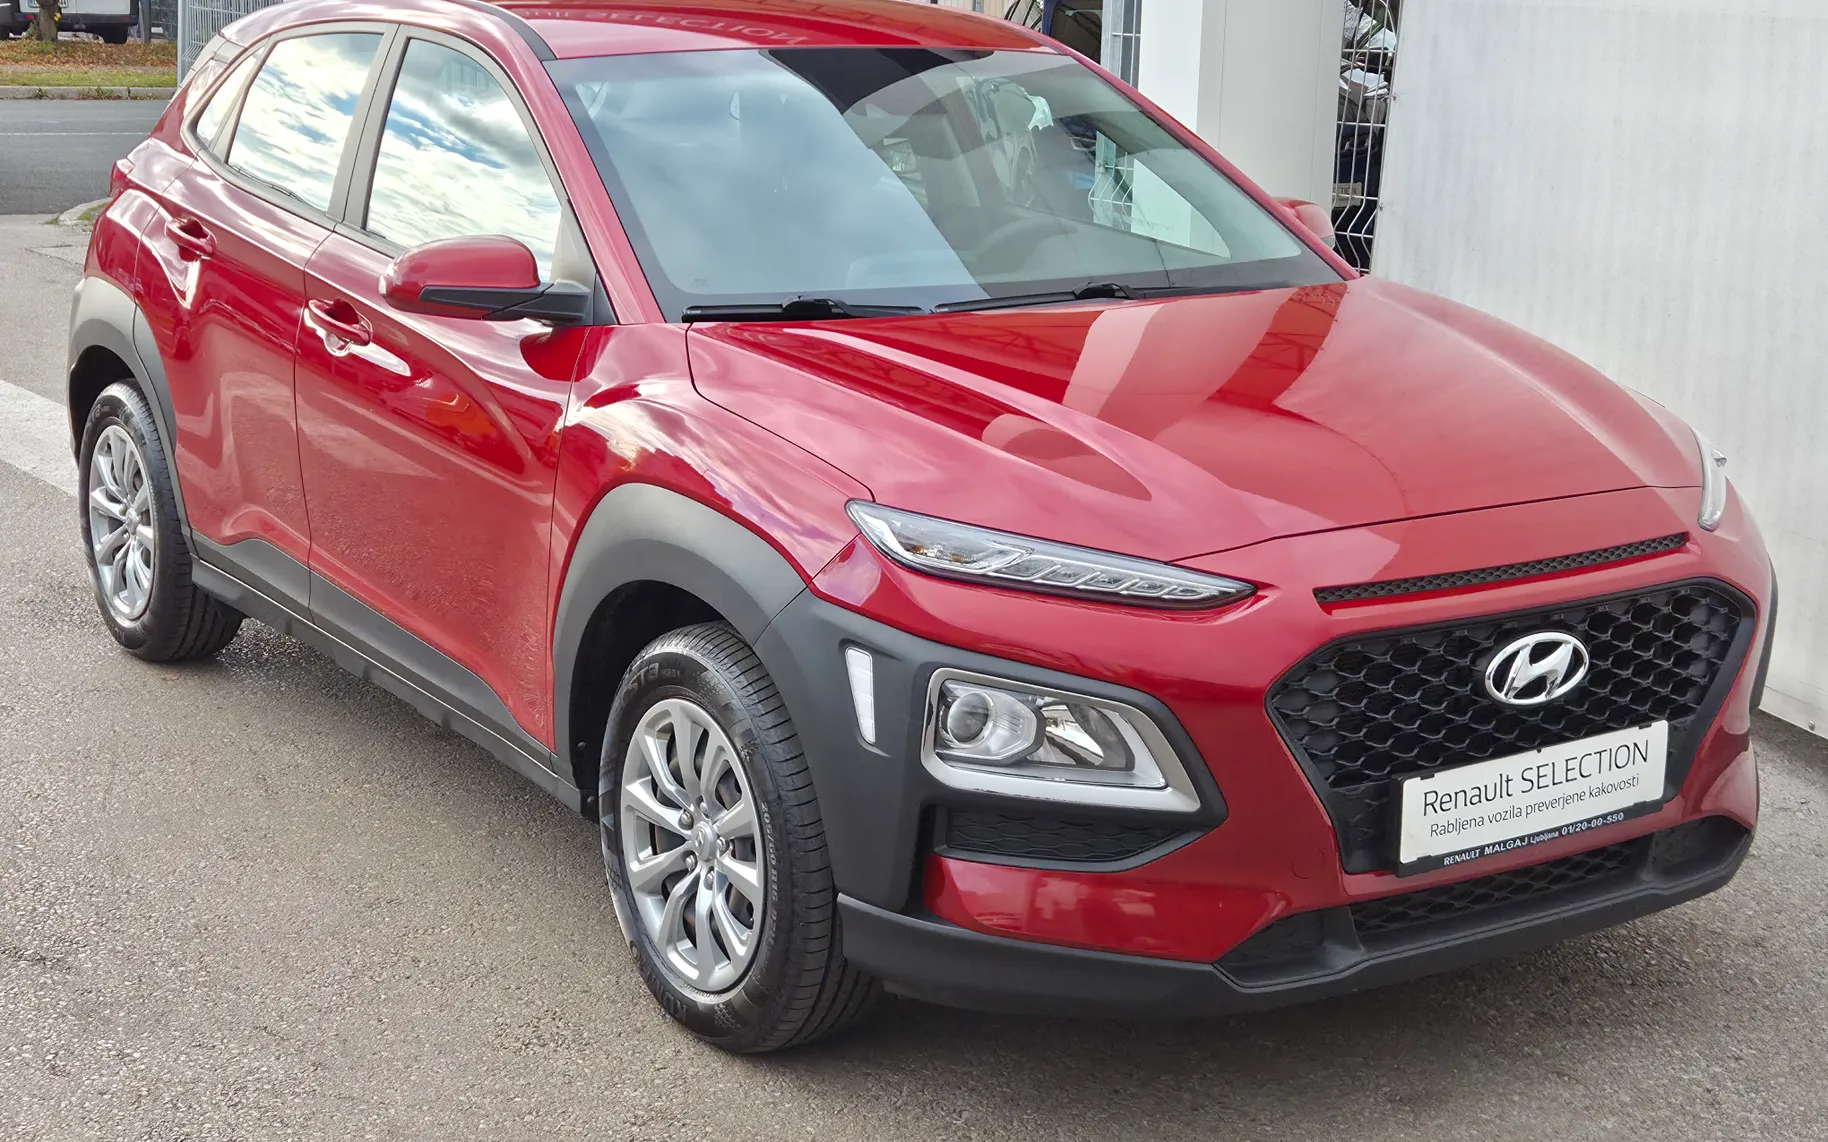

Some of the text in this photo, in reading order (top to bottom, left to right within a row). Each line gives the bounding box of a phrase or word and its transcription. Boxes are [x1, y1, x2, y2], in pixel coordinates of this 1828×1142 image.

[1423, 739, 1649, 816] Renault SELECTION
[1430, 773, 1640, 838] Rabljena vozila preverjene kakovosti
[1443, 849, 1481, 866] RENAULT
[1484, 837, 1528, 855] MALGAJ
[1561, 811, 1625, 836] 01/20-00-550
